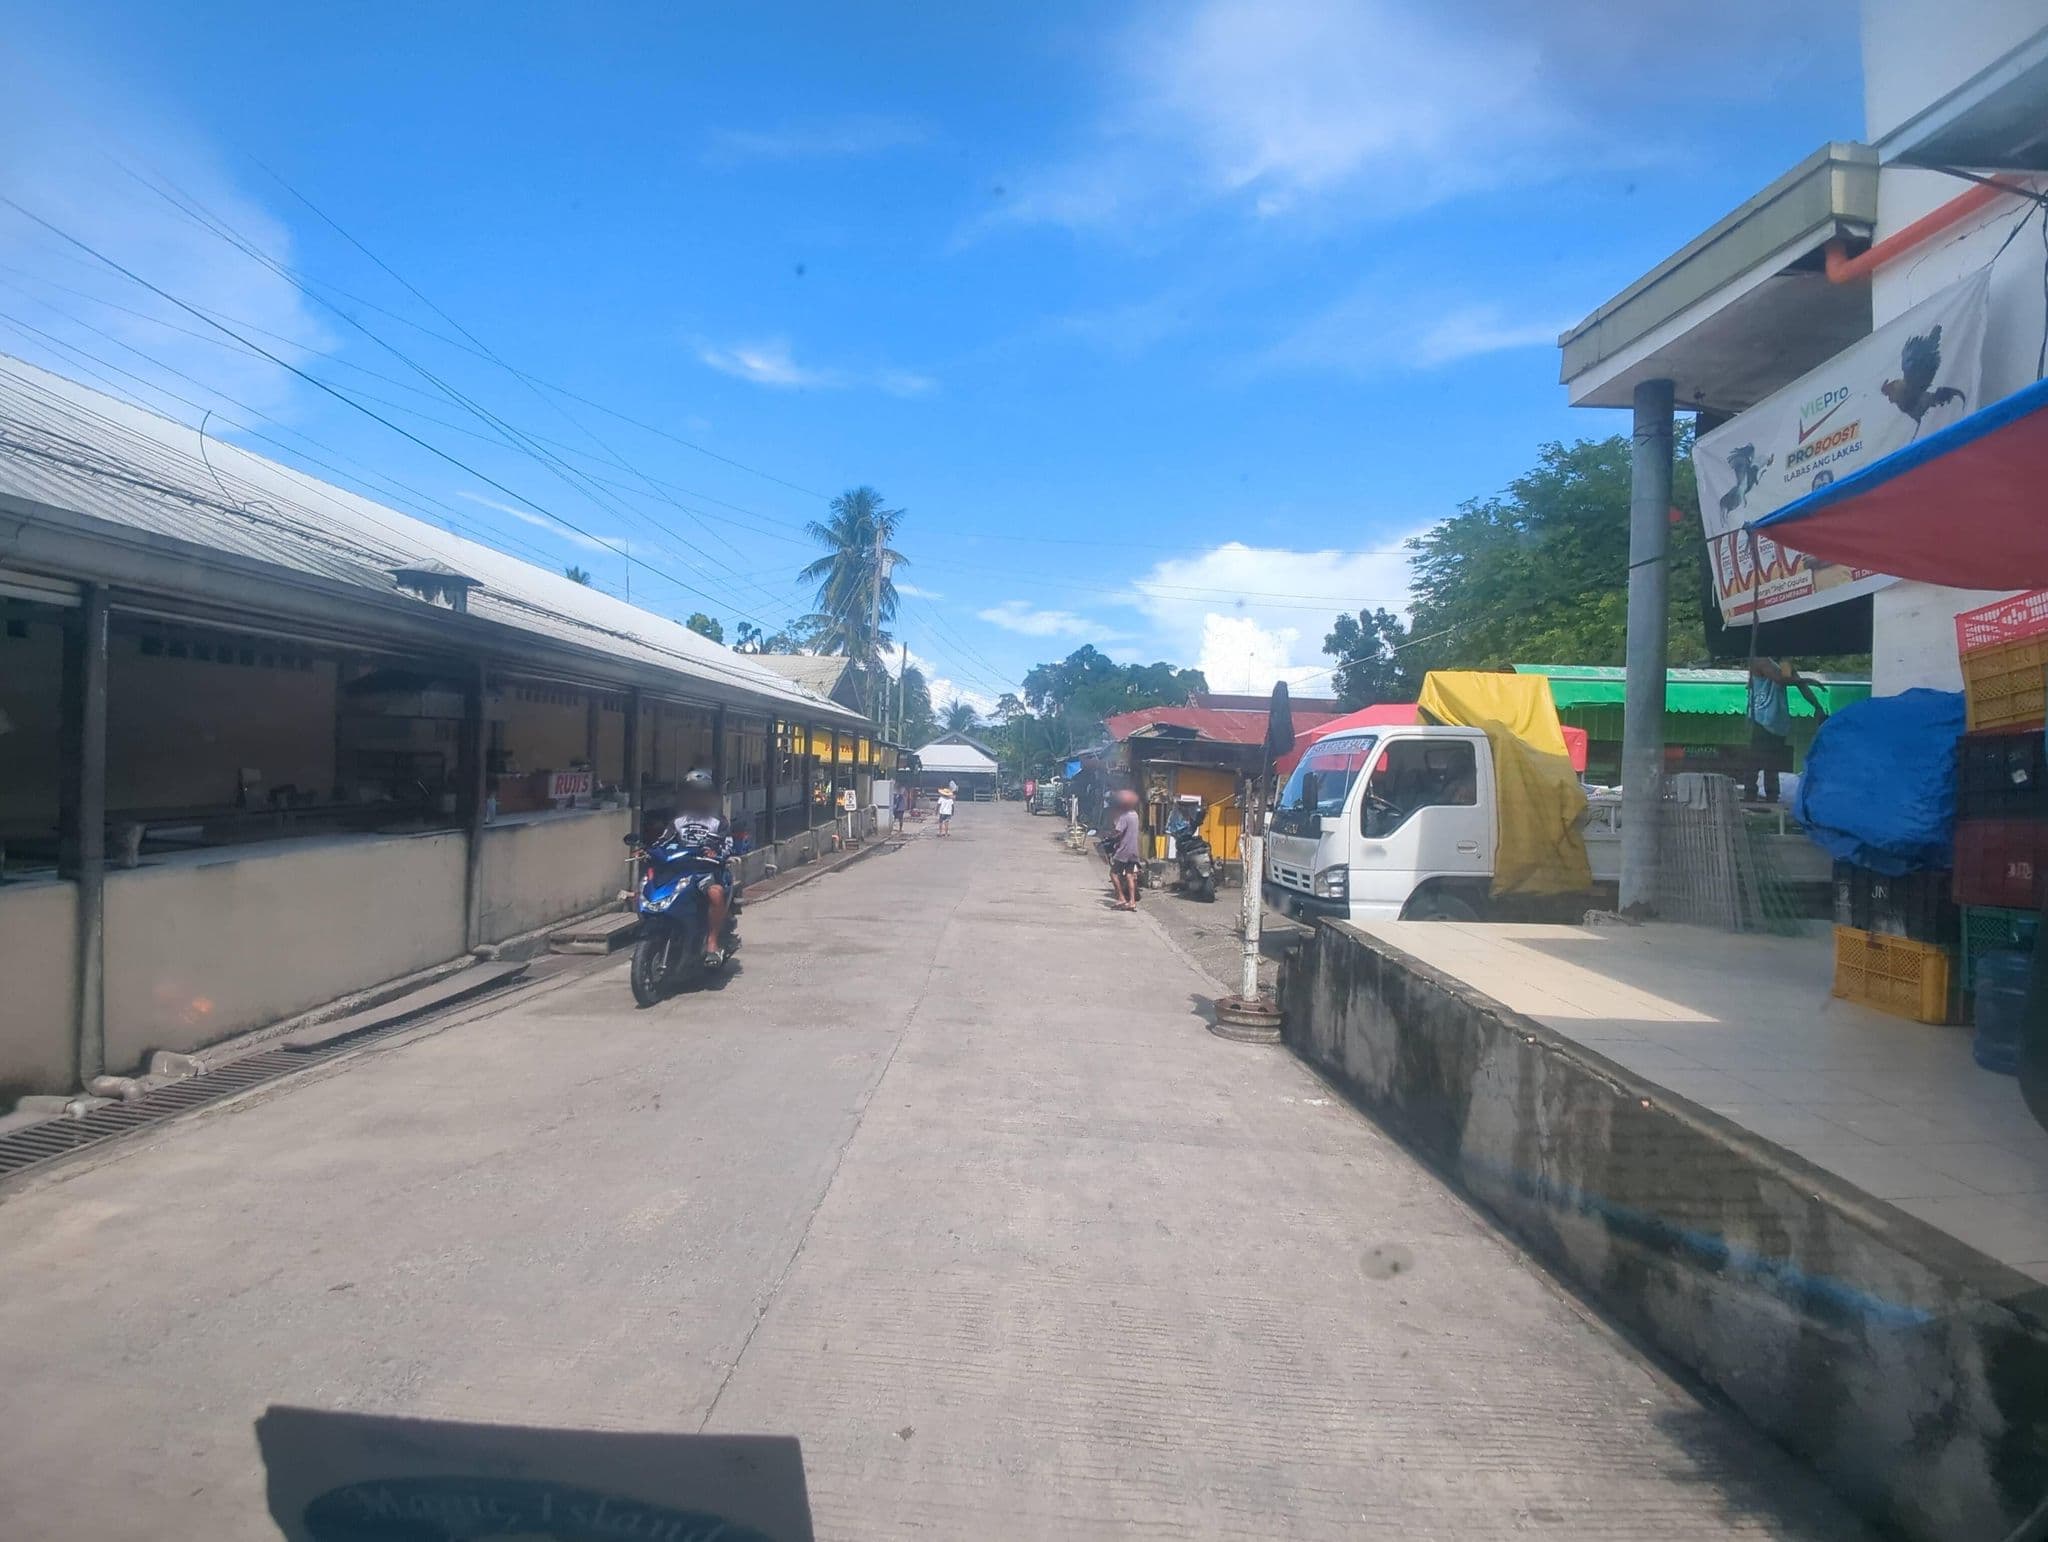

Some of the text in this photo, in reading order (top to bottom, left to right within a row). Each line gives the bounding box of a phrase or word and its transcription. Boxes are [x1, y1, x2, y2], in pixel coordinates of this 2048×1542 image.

[1784, 440, 1863, 483] ILABAS ANG LAKAS!
[1788, 421, 1859, 468] PROBOOST
